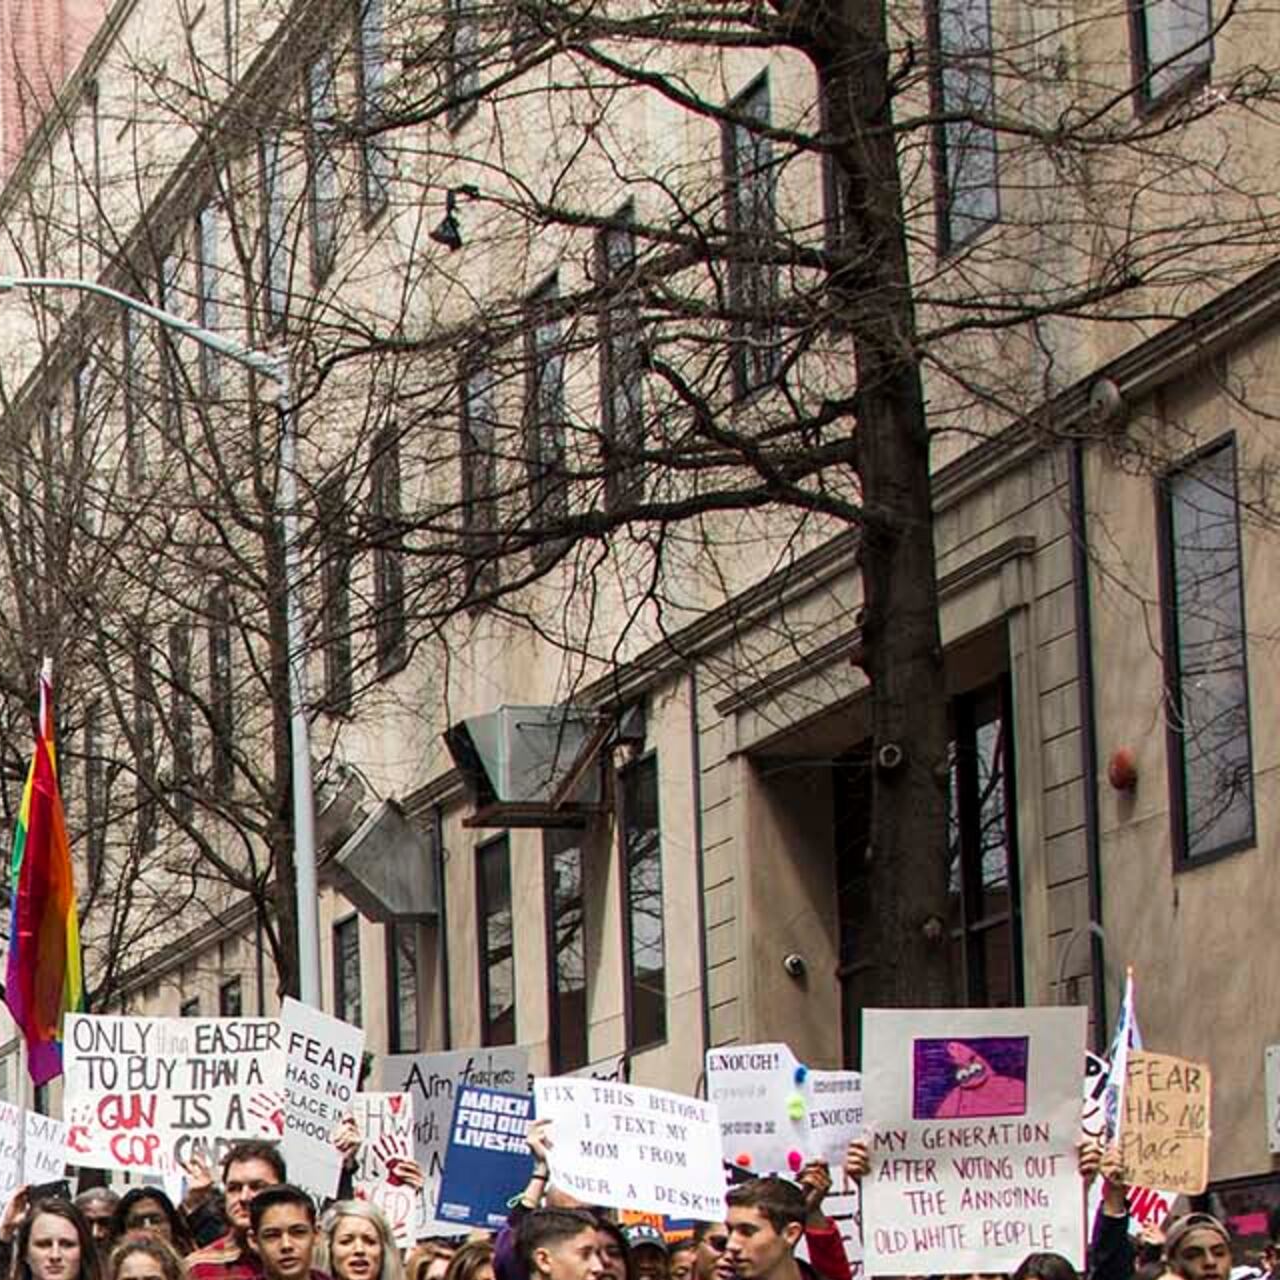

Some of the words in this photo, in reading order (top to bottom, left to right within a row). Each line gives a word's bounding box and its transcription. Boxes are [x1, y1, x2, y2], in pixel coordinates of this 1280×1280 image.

[73, 1018, 153, 1054] ONLY
[195, 1021, 281, 1054] EASIER
[288, 1032, 357, 1079] FEAR
[709, 1053, 780, 1072] ENOUGH!
[76, 1056, 118, 1089] TO
[127, 1056, 176, 1090] BUY
[187, 1058, 238, 1090] THAN
[246, 1058, 264, 1084] A
[285, 1064, 320, 1091] HAS
[325, 1077, 351, 1103] NO
[402, 1063, 453, 1099] Arm
[459, 1056, 515, 1088] teachers
[1125, 1059, 1201, 1094] FEAR
[97, 1094, 158, 1130] GUN
[170, 1095, 212, 1129] IS
[226, 1094, 246, 1130] A
[460, 1090, 529, 1116] MARCH
[543, 1086, 575, 1103] FIX
[592, 1087, 634, 1107] THIS
[649, 1093, 710, 1124] BEFORE
[1125, 1096, 1170, 1124] HAS
[457, 1108, 496, 1134] FOR
[584, 1113, 591, 1129] I
[612, 1115, 656, 1136] TEXT
[667, 1123, 688, 1142] MY
[874, 1130, 908, 1151] MY
[921, 1122, 1051, 1150] GENERATION
[110, 1134, 160, 1166] COP
[454, 1126, 507, 1151] LIVES
[580, 1140, 619, 1160] MOM
[639, 1146, 688, 1167] FROM
[1122, 1131, 1181, 1165] Place
[878, 1158, 938, 1184] AFTER
[953, 1156, 1014, 1181] VOTING
[1025, 1154, 1064, 1178] OUT
[627, 1184, 638, 1199] A
[903, 1189, 947, 1217] THE
[960, 1187, 1051, 1212] ANNOYING
[874, 1227, 909, 1255] OLD
[913, 1224, 967, 1252] WHITE
[982, 1220, 1054, 1250] PEOPLE
